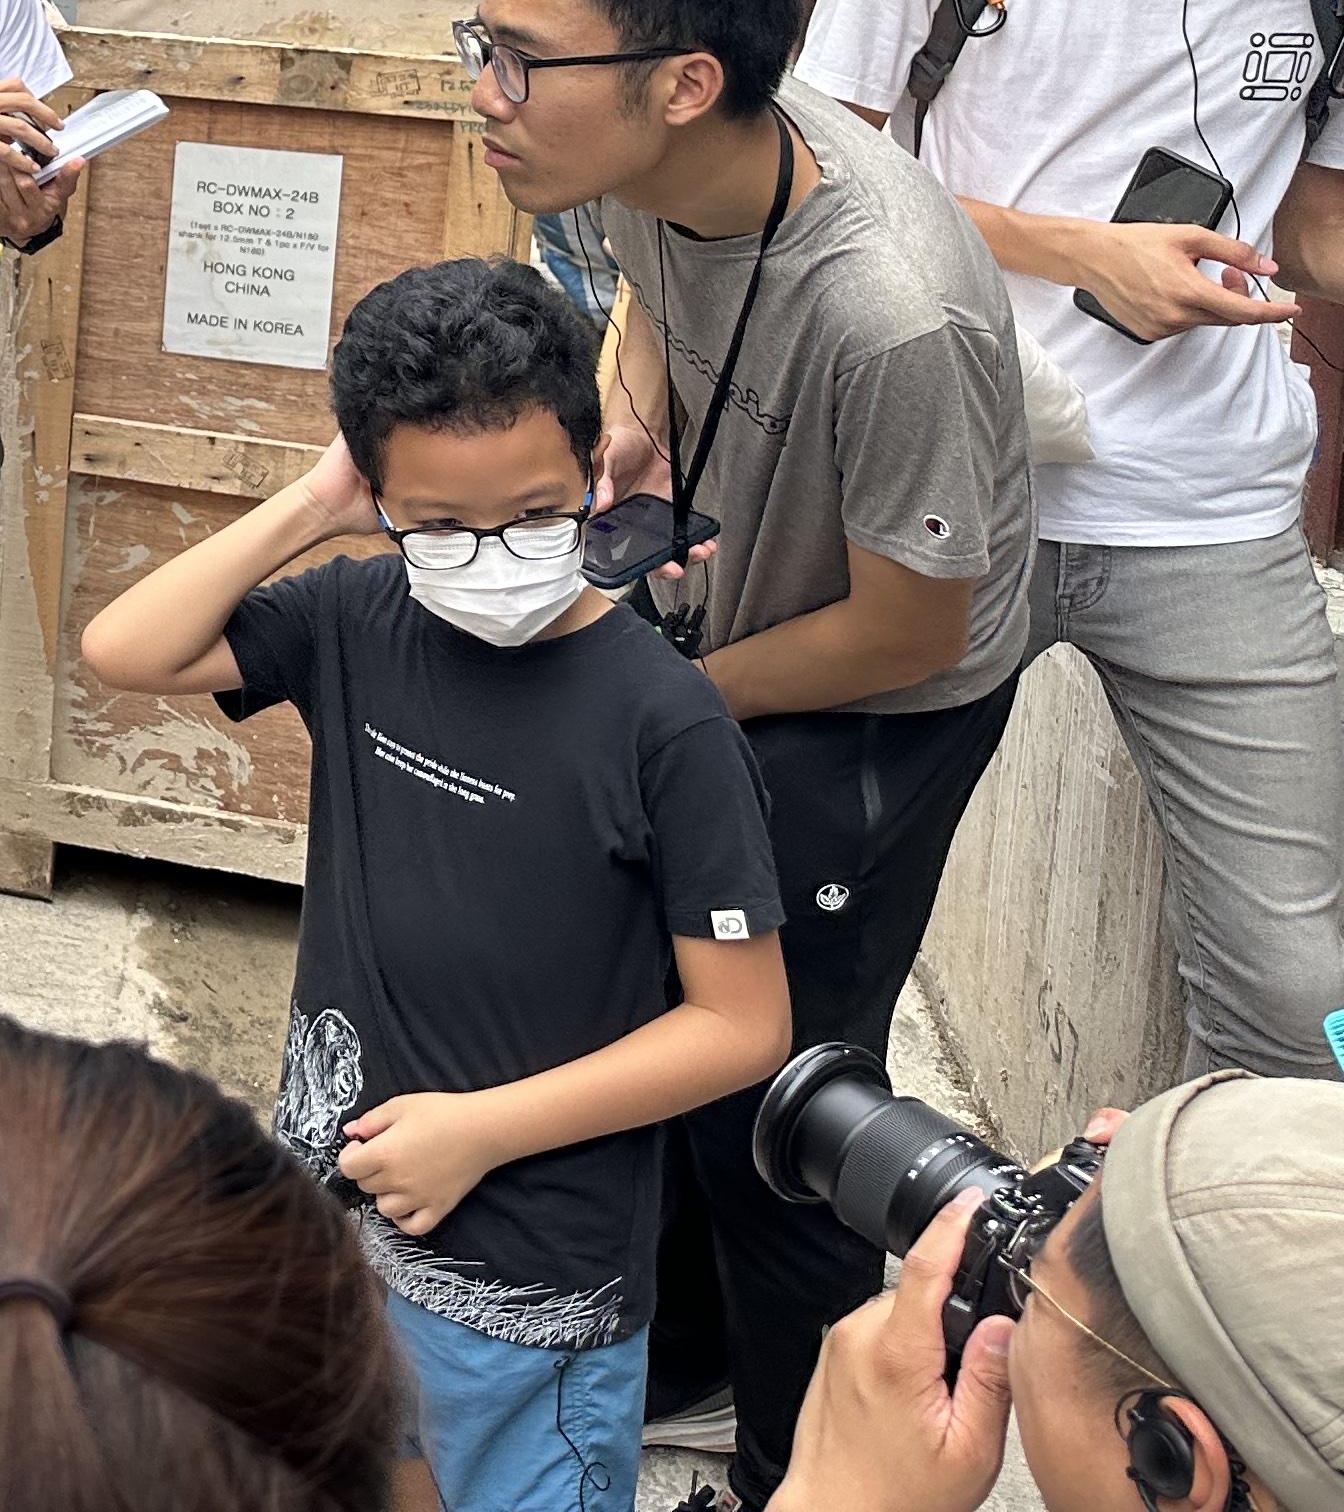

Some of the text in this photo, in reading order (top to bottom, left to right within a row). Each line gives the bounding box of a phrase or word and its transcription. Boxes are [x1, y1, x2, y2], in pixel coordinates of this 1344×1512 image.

[196, 180, 319, 204] RC-DWMAX-24B
[213, 200, 244, 216] BOX
[248, 204, 270, 218] NO
[285, 207, 295, 220] 2
[203, 261, 295, 282] HONG KONG
[224, 281, 271, 297] CHINA
[187, 311, 304, 337] MADE IN KOREA
